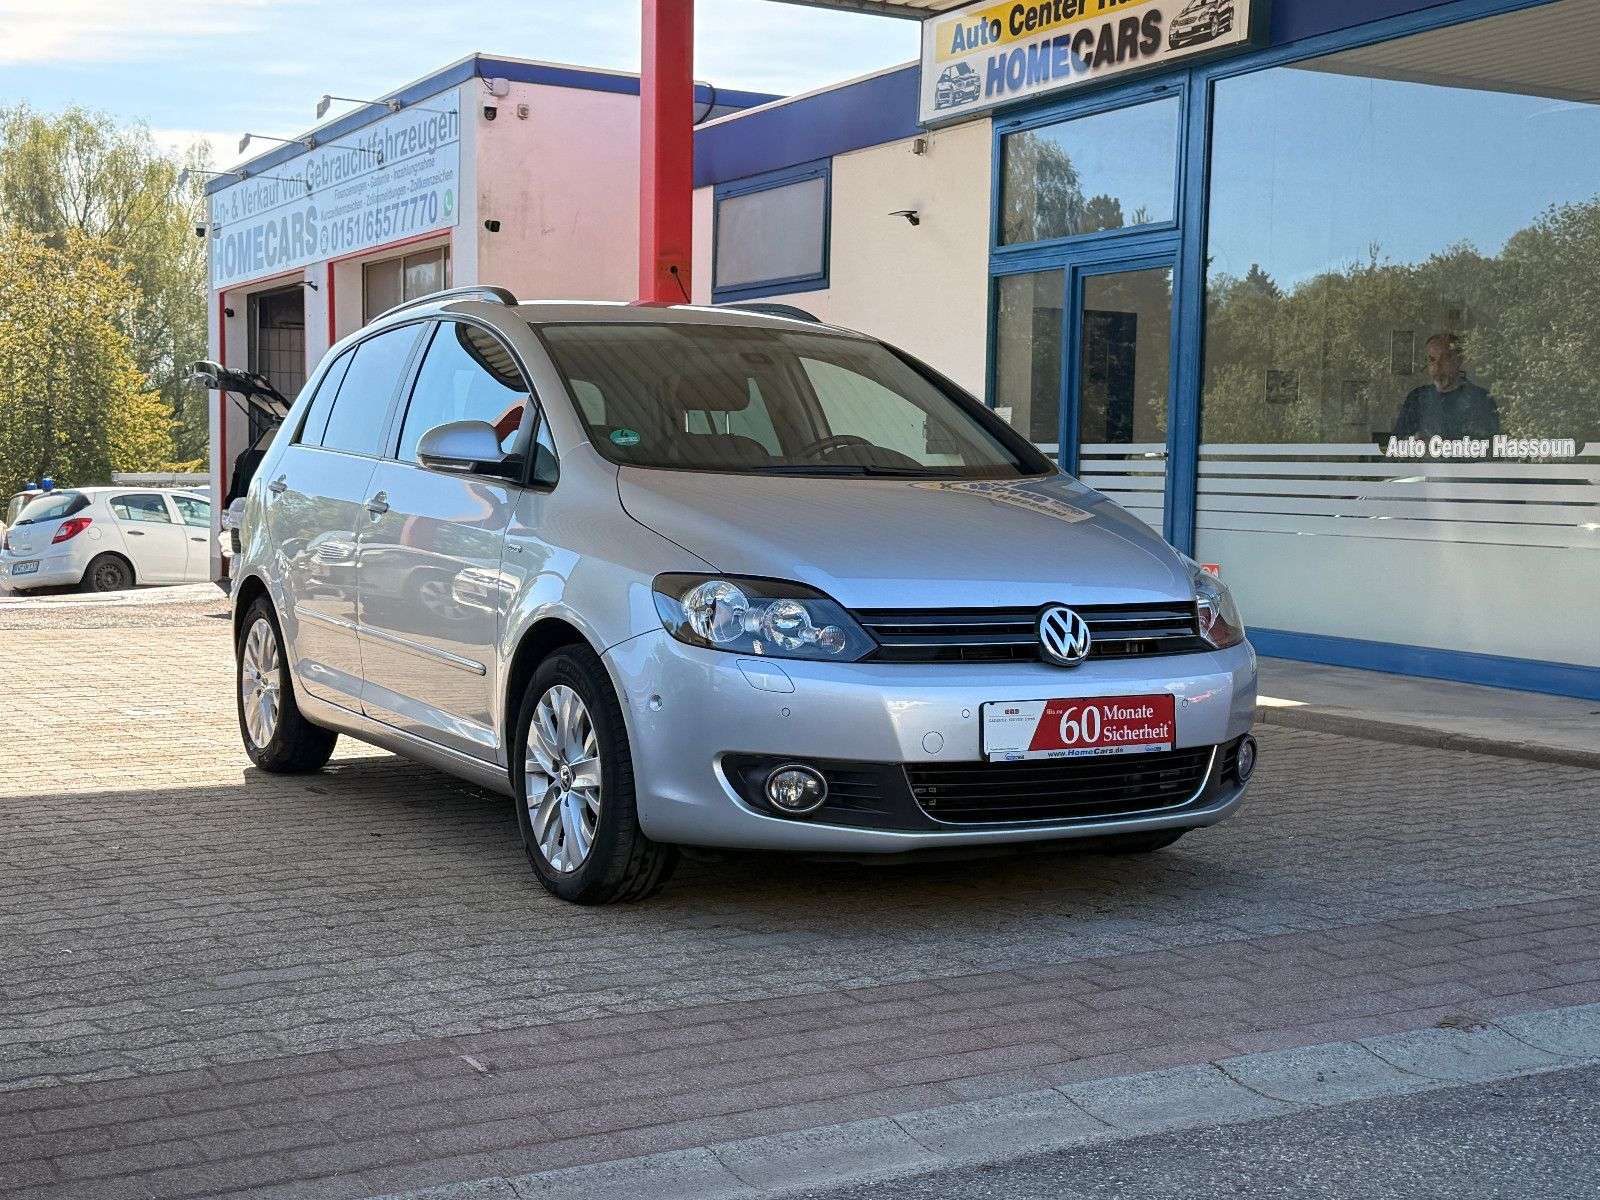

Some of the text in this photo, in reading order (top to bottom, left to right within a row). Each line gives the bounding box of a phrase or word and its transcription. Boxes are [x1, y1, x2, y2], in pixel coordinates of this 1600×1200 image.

[951, 0, 1085, 54] Auto Center
[985, 9, 1161, 97] HOMECARS
[231, 190, 239, 219] &
[241, 174, 279, 215] Verkauf
[281, 172, 304, 201] von
[305, 110, 457, 188] Gebrauchtfahrzeugen
[214, 205, 318, 280] HOMECARS
[331, 190, 438, 251] 0151/65577770
[1386, 434, 1576, 458] Auto Center Hassoun
[1040, 607, 1091, 661] VW
[1059, 705, 1101, 744] 60
[1103, 704, 1154, 720] Monate
[1047, 746, 1124, 758] www.HomeCars.de
